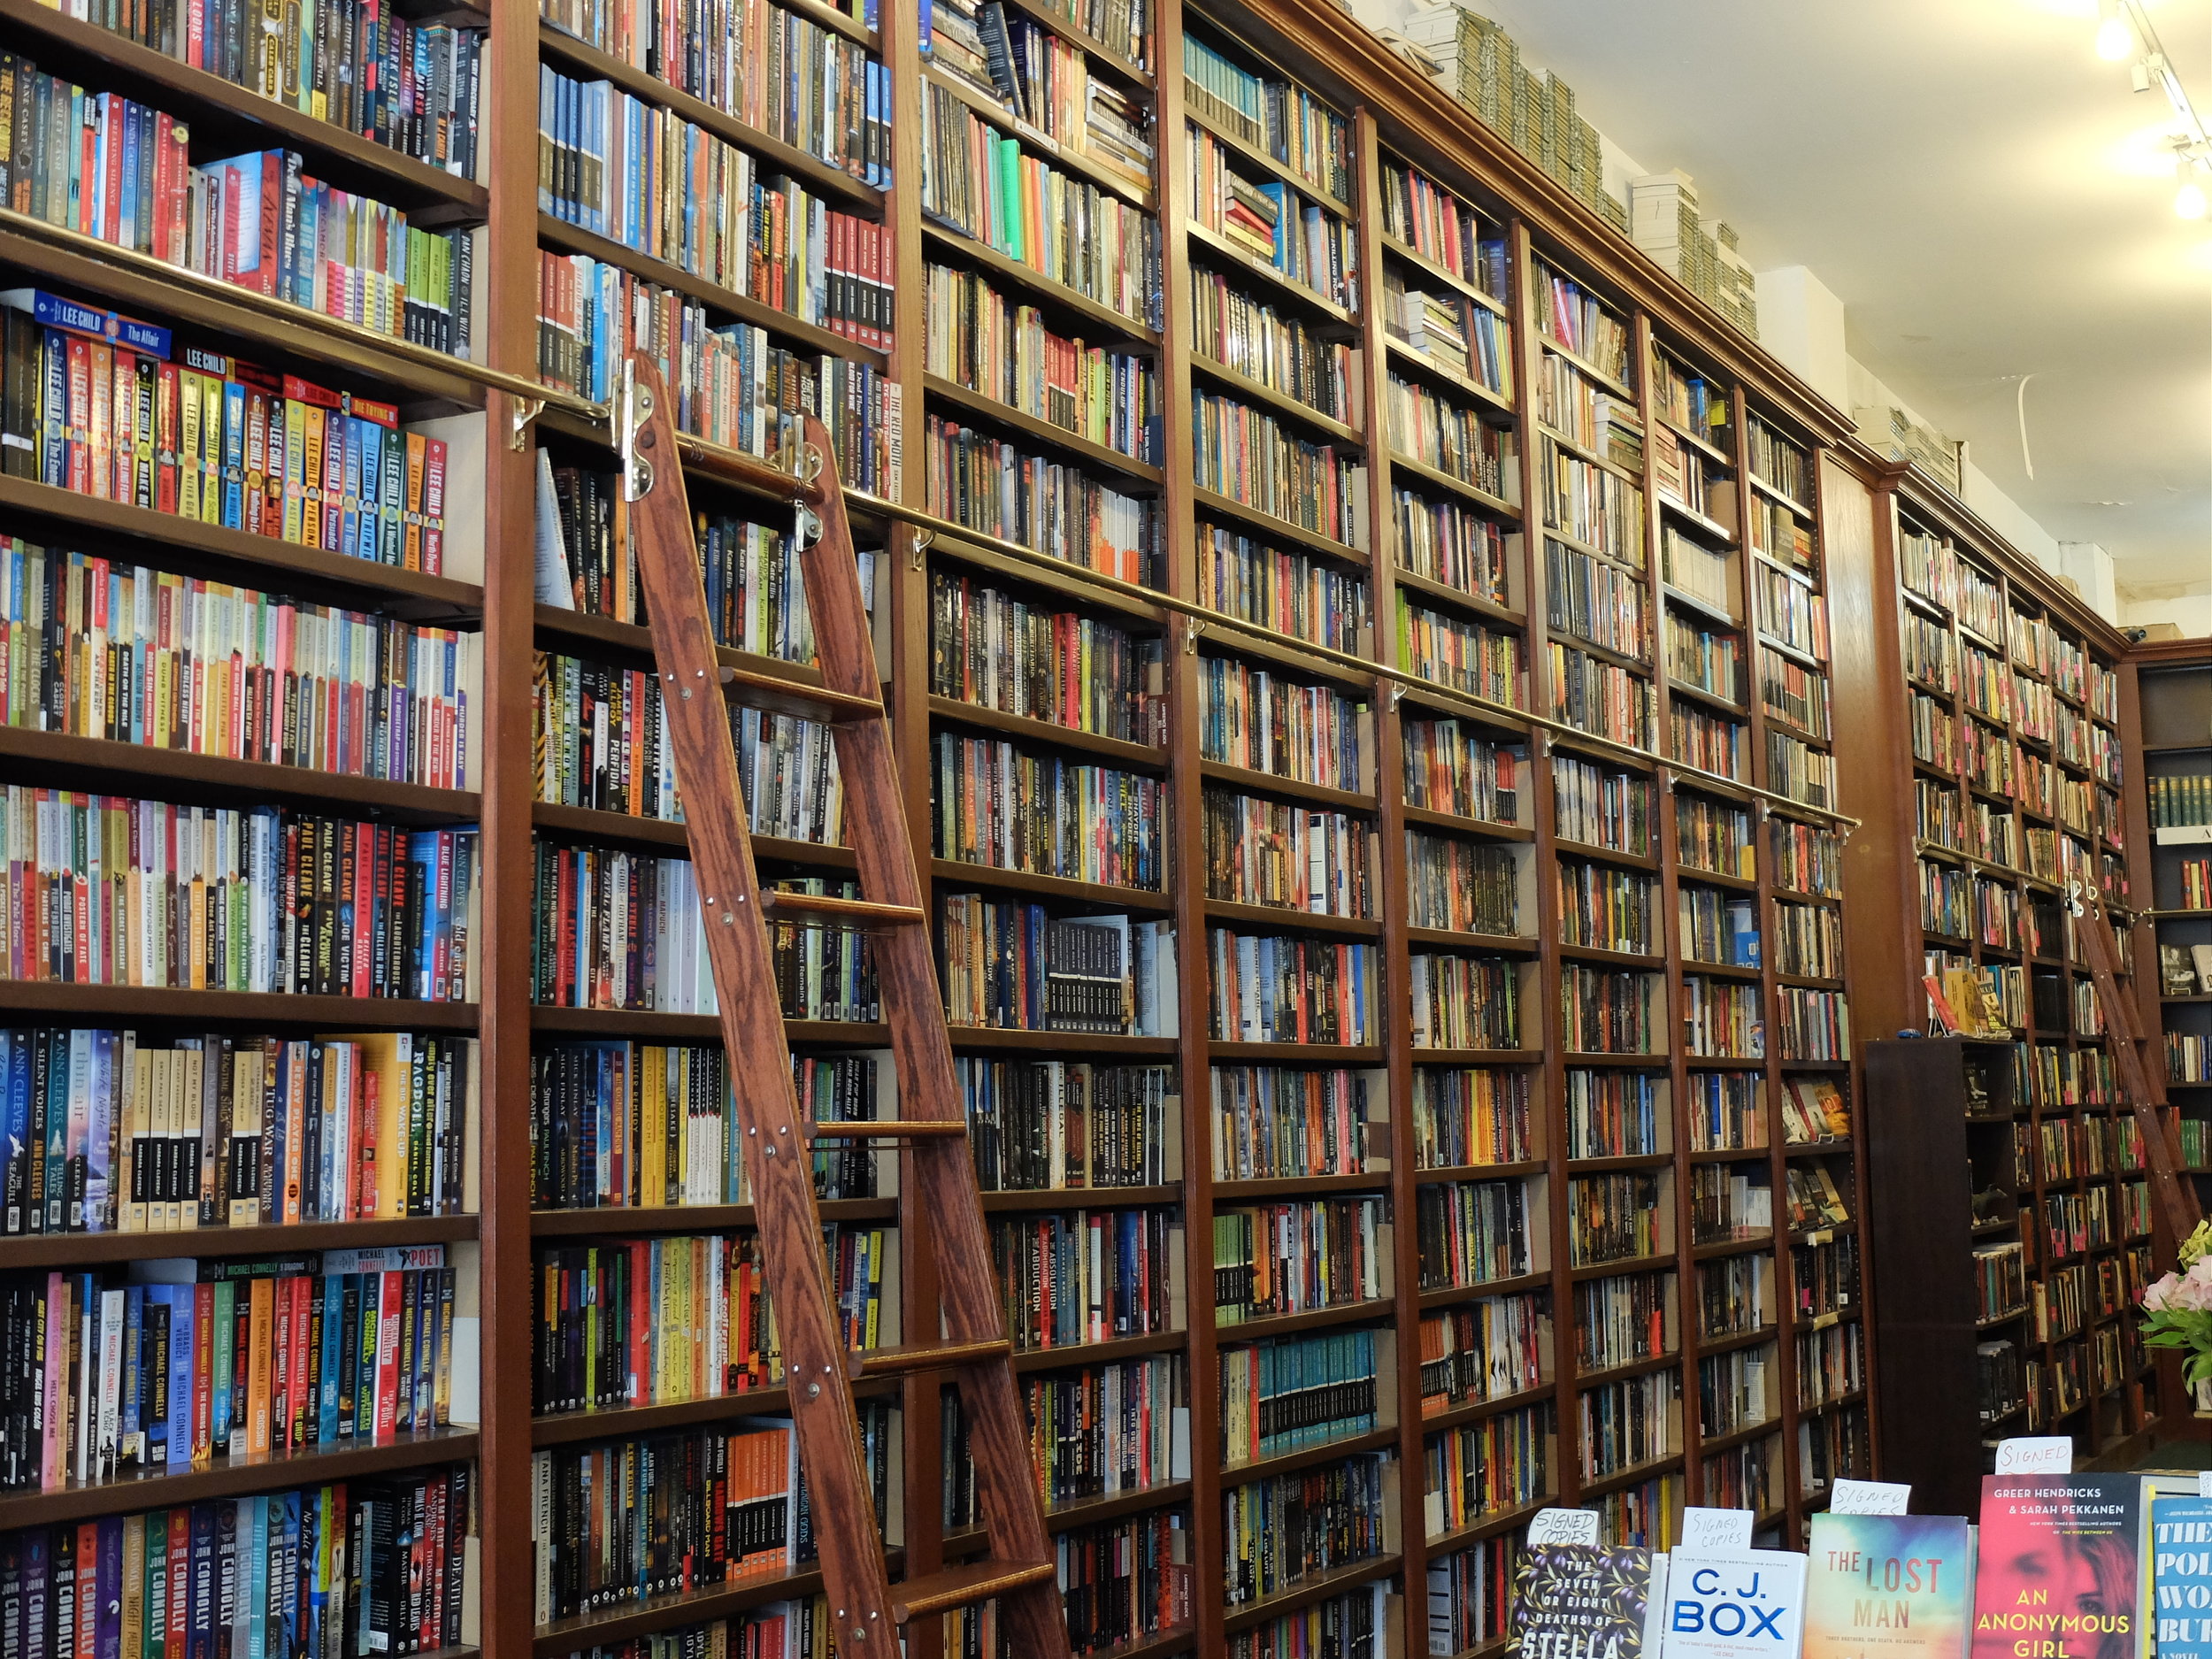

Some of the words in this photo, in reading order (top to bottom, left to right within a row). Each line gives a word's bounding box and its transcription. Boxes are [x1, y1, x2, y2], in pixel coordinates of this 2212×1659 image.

[389, 37, 400, 72] DARK
[417, 42, 426, 73] SALT
[388, 75, 398, 104] ISLE
[415, 73, 426, 115] MARSH
[288, 158, 296, 195] Dead
[286, 196, 296, 230] Man's
[285, 232, 295, 270] Blues
[63, 306, 77, 325] LEE
[78, 311, 100, 332] CHILD
[128, 325, 140, 341] The
[142, 329, 159, 348] Affair
[187, 348, 202, 368] LEE
[203, 353, 226, 374] CHILD
[51, 368, 62, 390] LEE
[50, 390, 62, 420] CHILD
[140, 389, 150, 411] LEE
[354, 400, 365, 413] DIE
[366, 403, 388, 420] TRYING
[140, 411, 150, 441] CHILD
[51, 442, 60, 457] The
[330, 443, 340, 460] LEE
[346, 449, 356, 464] LEE
[365, 452, 374, 467] LEE
[139, 462, 149, 490] MAKE
[327, 462, 340, 489] CHILD
[345, 465, 356, 490] CHILD
[365, 470, 374, 494] CHILD
[429, 469, 442, 486] LEE
[428, 487, 442, 515] CHILD
[327, 509, 339, 549] Persuader
[345, 524, 354, 534] 61
[428, 534, 438, 549] Worth
[426, 550, 437, 570] Dying
[122, 678, 129, 690] ON
[610, 740, 619, 790] PERFIDIA
[302, 823, 313, 850] PAUL
[324, 822, 333, 849] PAUL
[342, 826, 353, 854] PAUL
[441, 846, 449, 865] BLUE
[300, 856, 312, 897] CLEAVE
[322, 852, 332, 893] CLEAVE
[342, 858, 352, 901] CLEAVE
[439, 868, 449, 910] LIGHTNING
[456, 870, 465, 906] CLEEVES
[80, 933, 86, 943] OF
[452, 917, 465, 941] cold
[300, 936, 311, 979] CLEANER
[341, 946, 349, 982] VICTIM
[451, 946, 464, 975] earth
[36, 1048, 45, 1085] SILENT
[293, 1065, 302, 1103] READY
[411, 1051, 425, 1132] RAGDOLL
[35, 1088, 44, 1129] VOICES
[265, 1089, 276, 1119] TUG
[264, 1125, 275, 1156] WAR
[291, 1109, 300, 1152] PLAYER
[33, 1140, 42, 1158] ANN
[31, 1160, 42, 1199] CLEEVES
[410, 1248, 440, 1267] POET
[156, 1341, 165, 1375] MICHAEL
[156, 1378, 165, 1417] CONNELLY
[2001, 1445, 2069, 1466] SIGNED
[1836, 1486, 1903, 1503] SIGNED
[1994, 1488, 2031, 1498] GREER
[2035, 1488, 2101, 1498] HENDRICKS
[1536, 1512, 1594, 1529] SIGNED
[1694, 1514, 1738, 1532] SIGNED
[2008, 1505, 2016, 1514] &
[2020, 1505, 2057, 1514] SARAH
[2062, 1505, 2124, 1514] PEKKANEN
[1540, 1530, 1590, 1545] COPIES
[1701, 1532, 1741, 1547] COPIES
[1567, 1561, 1591, 1571] THE
[1828, 1551, 1861, 1571] THE
[1866, 1557, 1942, 1593] LOST
[1555, 1578, 1598, 1589] SEVEN
[1693, 1568, 1726, 1595] C.
[1736, 1572, 1766, 1598] J.
[151, 1571, 165, 1641] CONNOLLY
[1543, 1596, 1559, 1606] OR
[1567, 1596, 1608, 1608] EIGHT
[2016, 1589, 2047, 1605] AN
[1535, 1614, 1587, 1624] DEATHS
[1595, 1616, 1611, 1626] OF
[1672, 1600, 1786, 1640] BOX
[1854, 1599, 1909, 1628] MAN
[1978, 1614, 2130, 1633] ANONYMOUS
[1522, 1632, 1618, 1659] STELLA
[2014, 1640, 2070, 1658] GIRL
